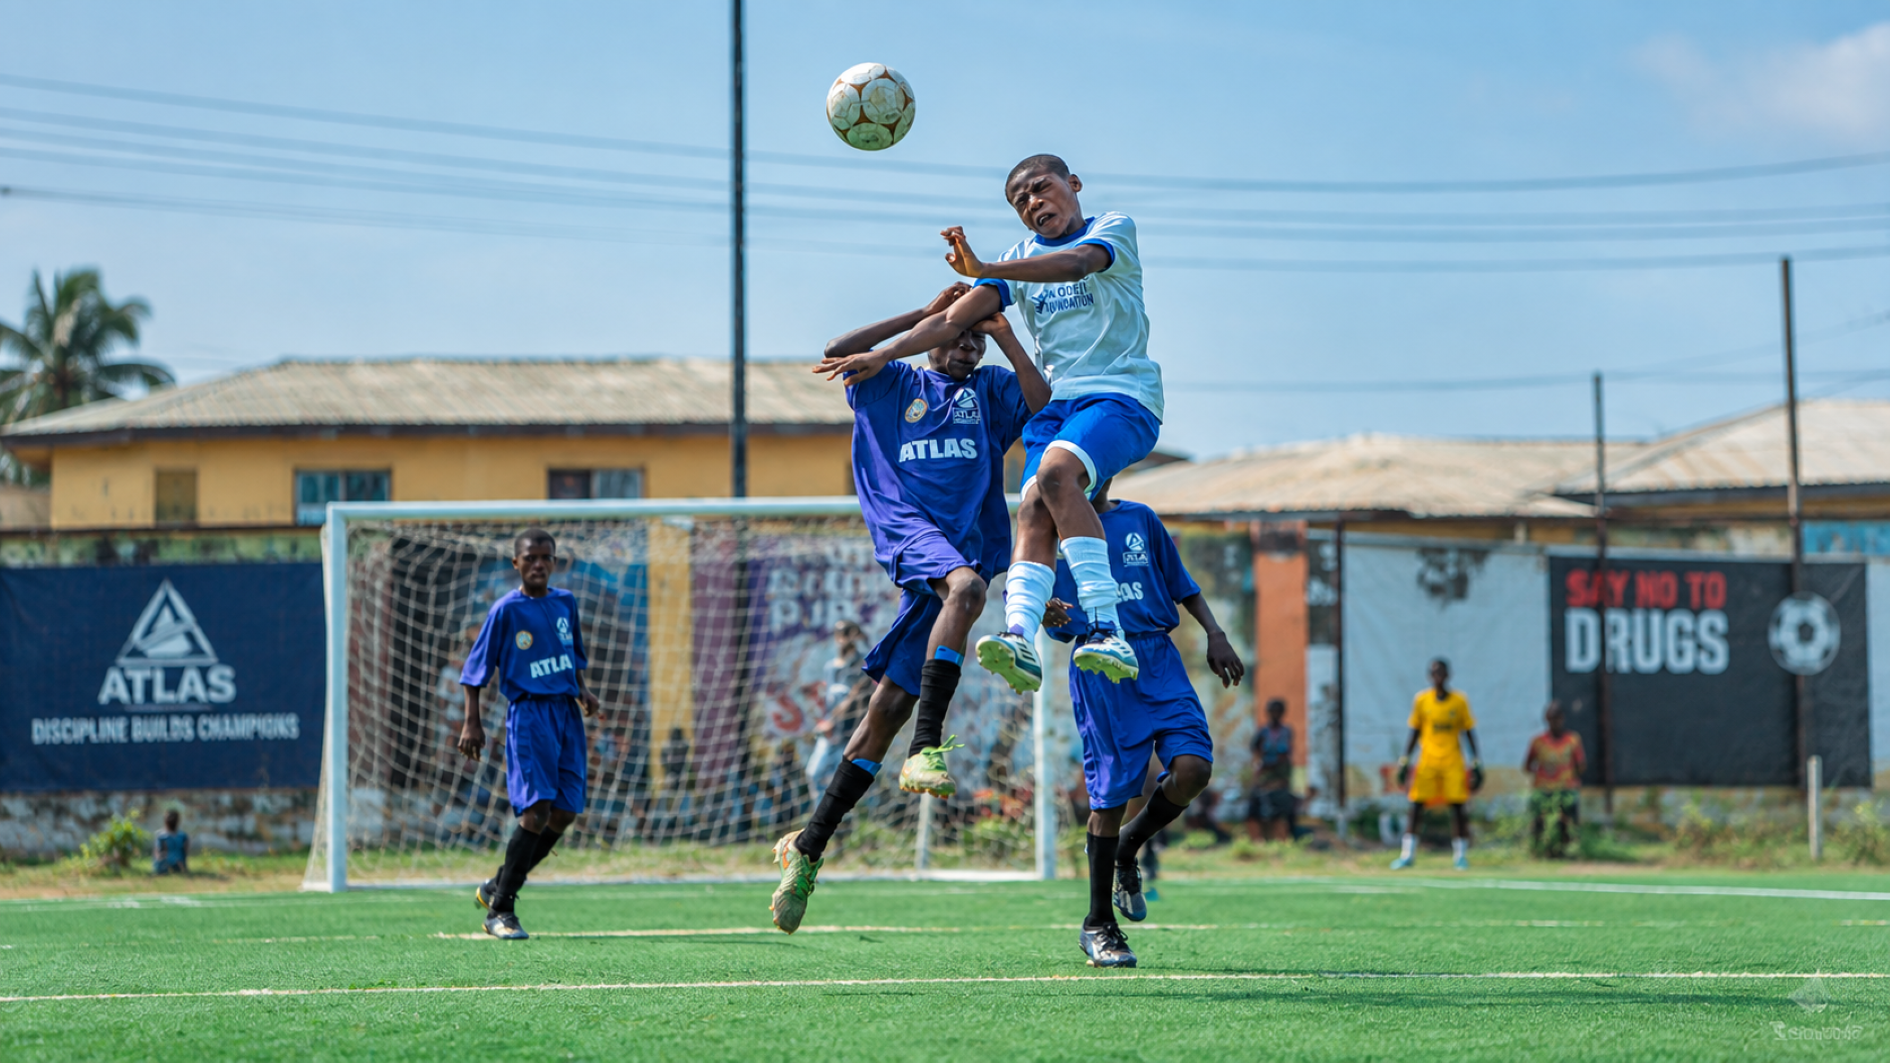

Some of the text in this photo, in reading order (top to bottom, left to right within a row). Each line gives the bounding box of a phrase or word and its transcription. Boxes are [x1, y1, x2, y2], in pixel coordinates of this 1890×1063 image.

[899, 438, 977, 462] ATLAS
[1117, 581, 1144, 601] AS
[1565, 568, 1727, 609] SAY NO TO
[1564, 607, 1730, 675] DRUGS
[98, 665, 236, 705] ATLAS
[31, 712, 300, 745] DISCIPLINE BUILDS CHAMPIONS
